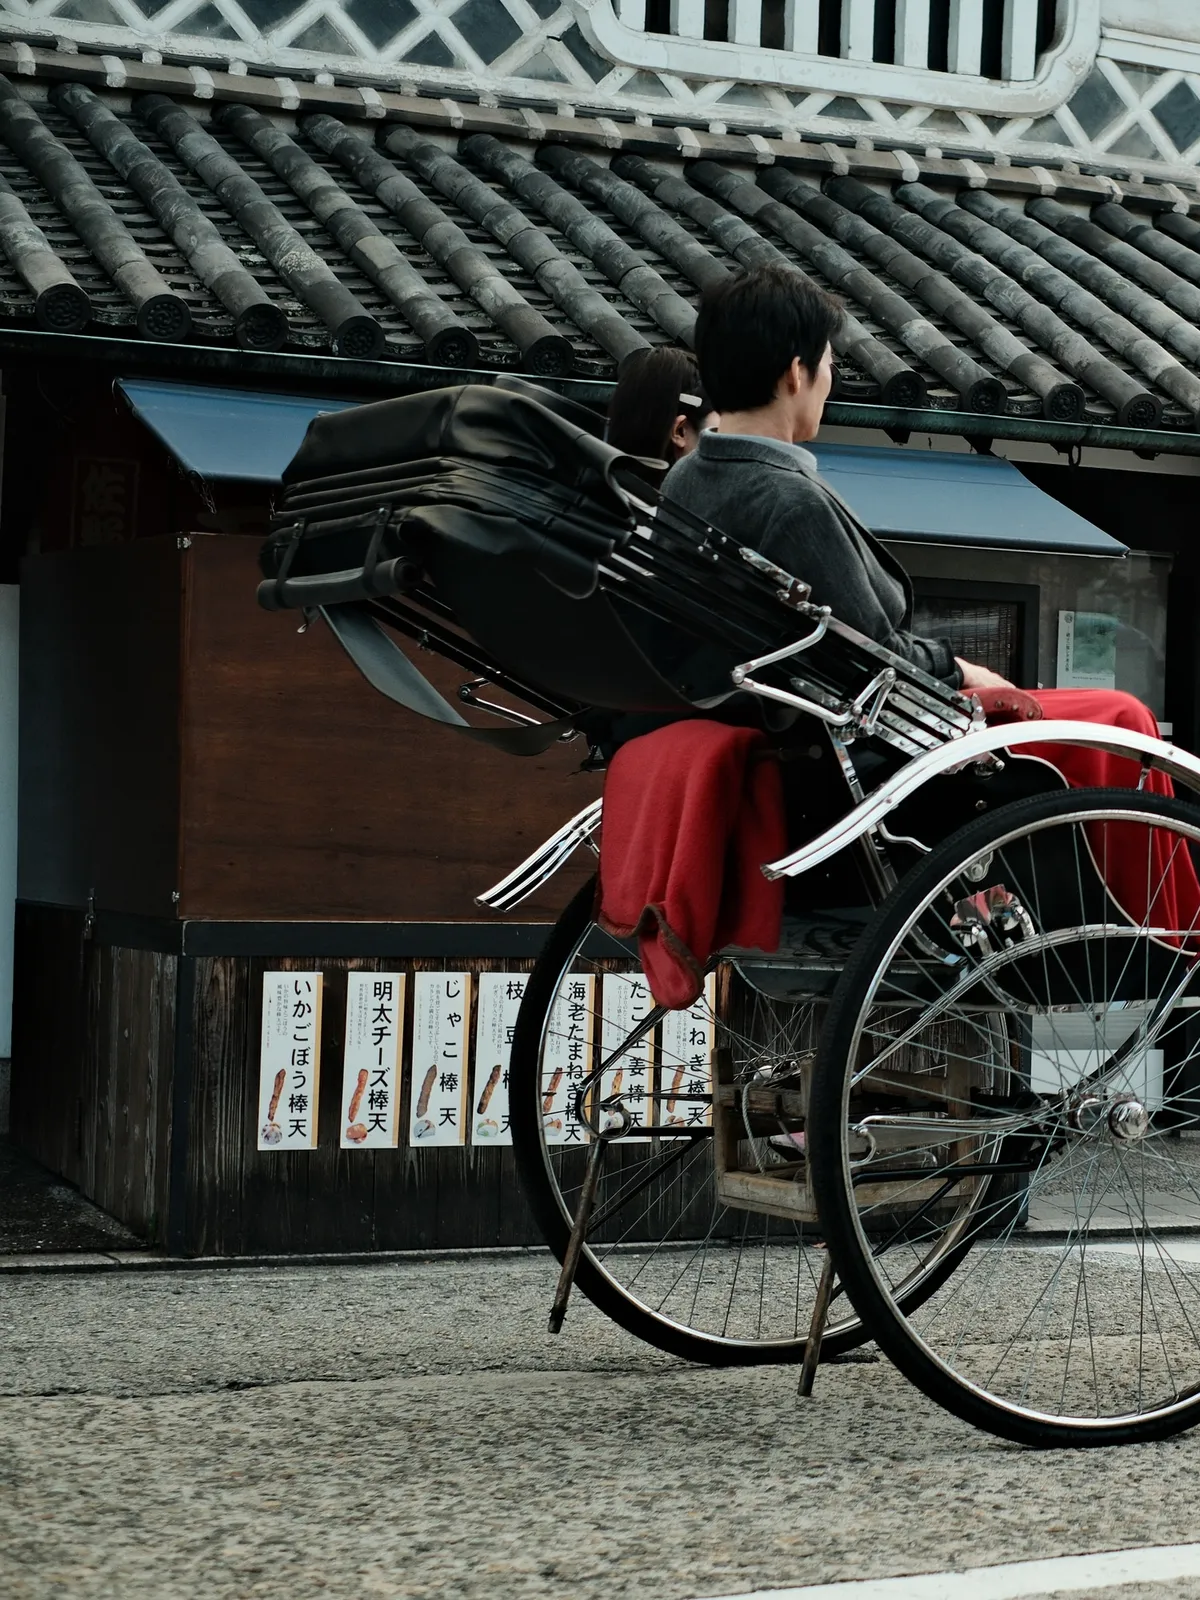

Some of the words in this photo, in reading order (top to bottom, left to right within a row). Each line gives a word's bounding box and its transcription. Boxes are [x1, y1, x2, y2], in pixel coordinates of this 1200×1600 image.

[288, 979, 312, 1138] いかごぼう棒天
[367, 981, 393, 1133] 明太チーズ棒天
[439, 979, 462, 1127] じゃこ棒天
